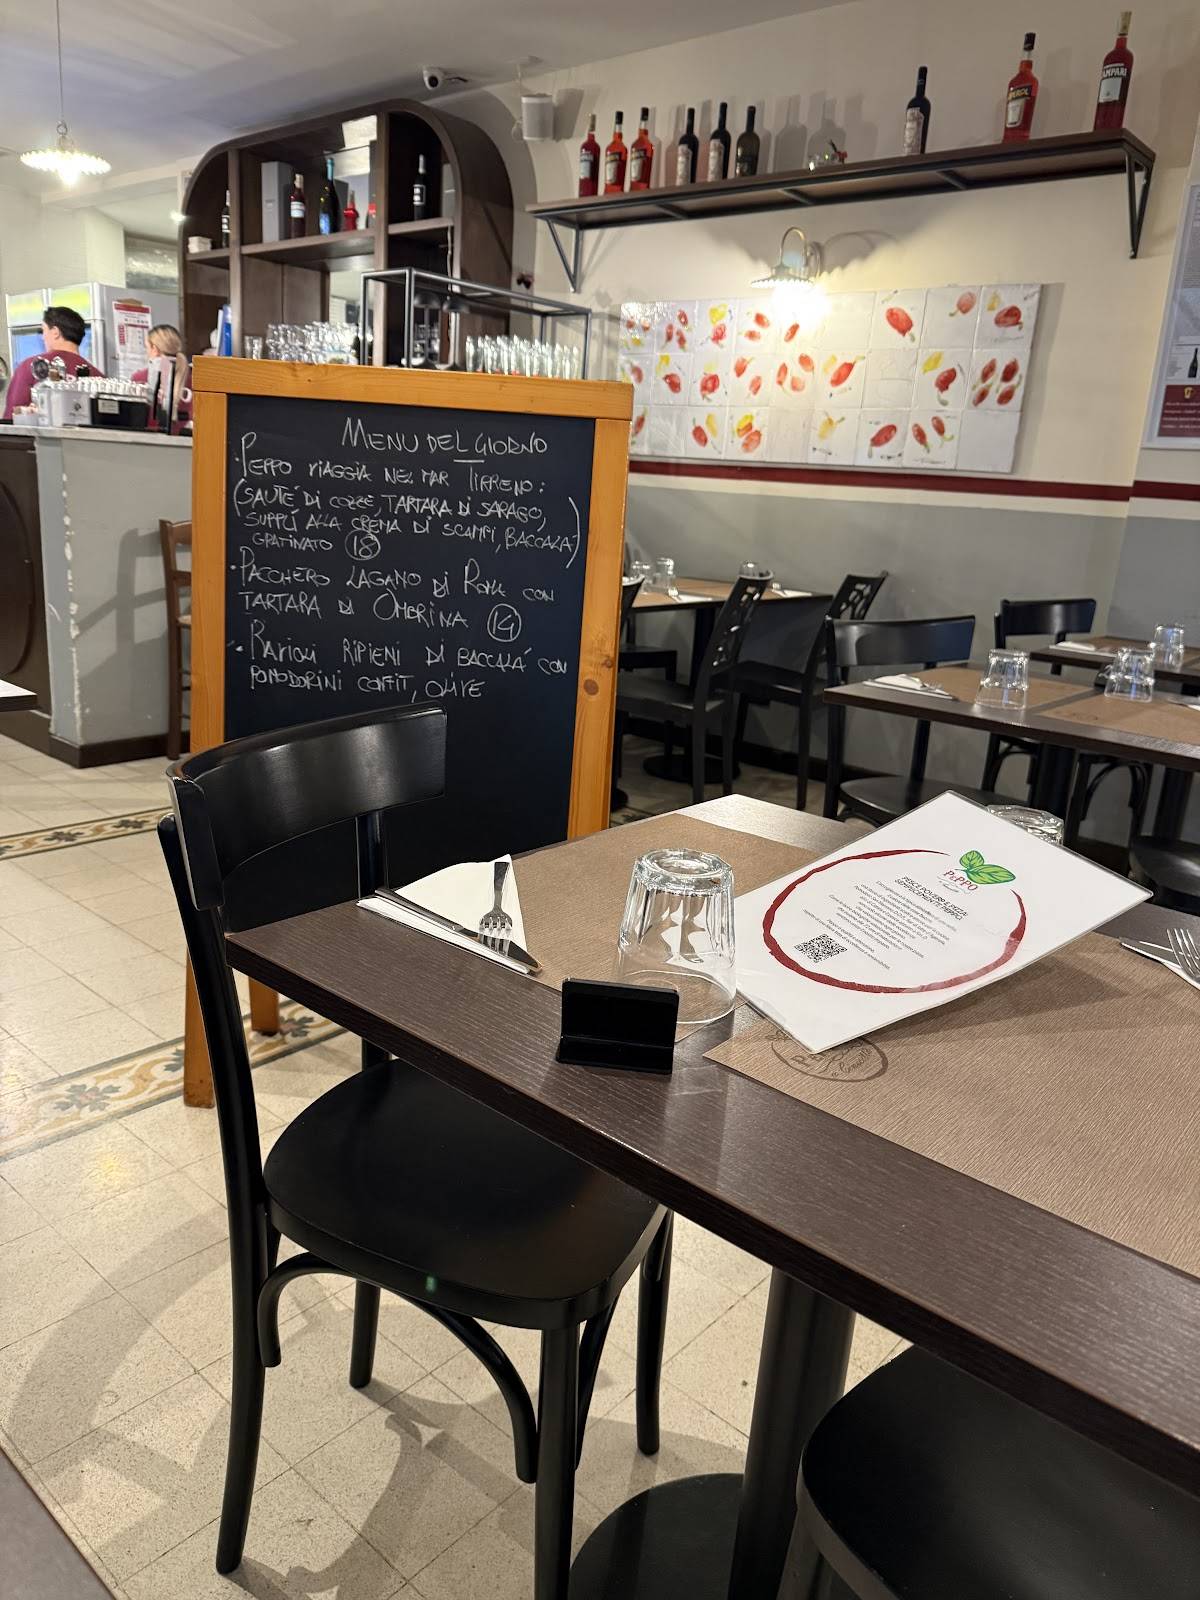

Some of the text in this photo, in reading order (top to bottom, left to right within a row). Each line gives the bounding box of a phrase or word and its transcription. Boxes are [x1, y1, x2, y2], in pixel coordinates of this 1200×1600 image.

[342, 417, 548, 456] MENU DEL GIORNO
[241, 431, 292, 477] PEPPO
[381, 495, 452, 518] TARTARA
[305, 513, 342, 531] ALLA
[238, 591, 322, 619] TARTARA
[523, 588, 554, 601] CON
[537, 658, 567, 675] CON
[425, 672, 485, 698] OLIVE
